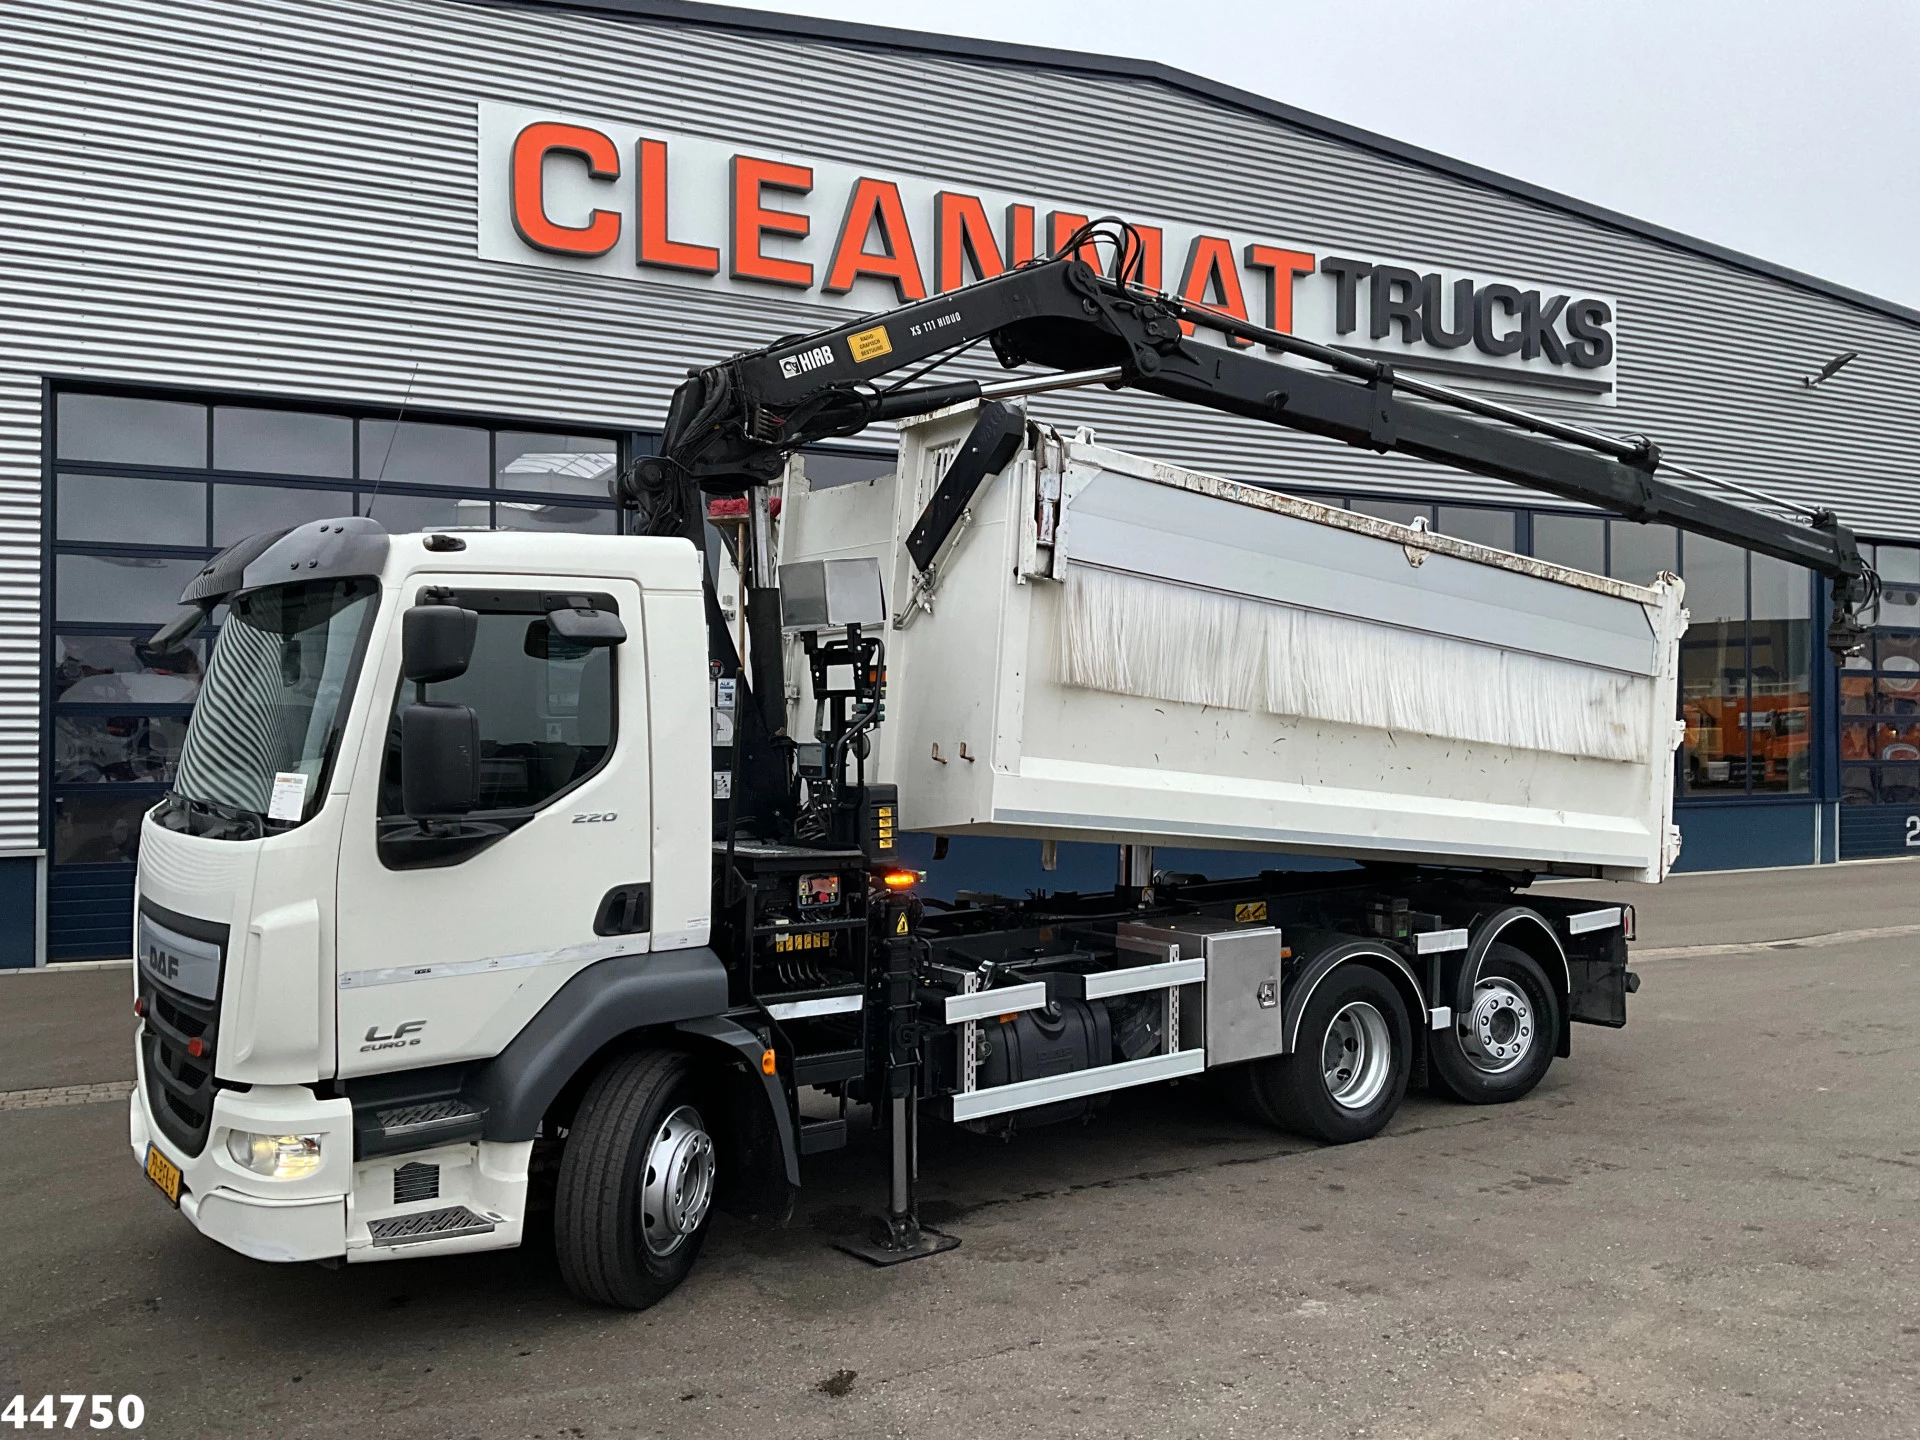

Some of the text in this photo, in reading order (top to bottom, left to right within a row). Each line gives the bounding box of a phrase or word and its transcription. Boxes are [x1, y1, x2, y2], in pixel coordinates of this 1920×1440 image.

[508, 120, 1614, 369] CLEANMAT TRUCKS
[909, 311, 962, 337] XS 111 HIDUO
[798, 345, 834, 372] HIAB
[571, 812, 618, 823] 220
[1905, 815, 1920, 846] 2
[149, 944, 179, 980] DAF
[364, 1019, 427, 1042] LF
[360, 1038, 421, 1052] EURO 6
